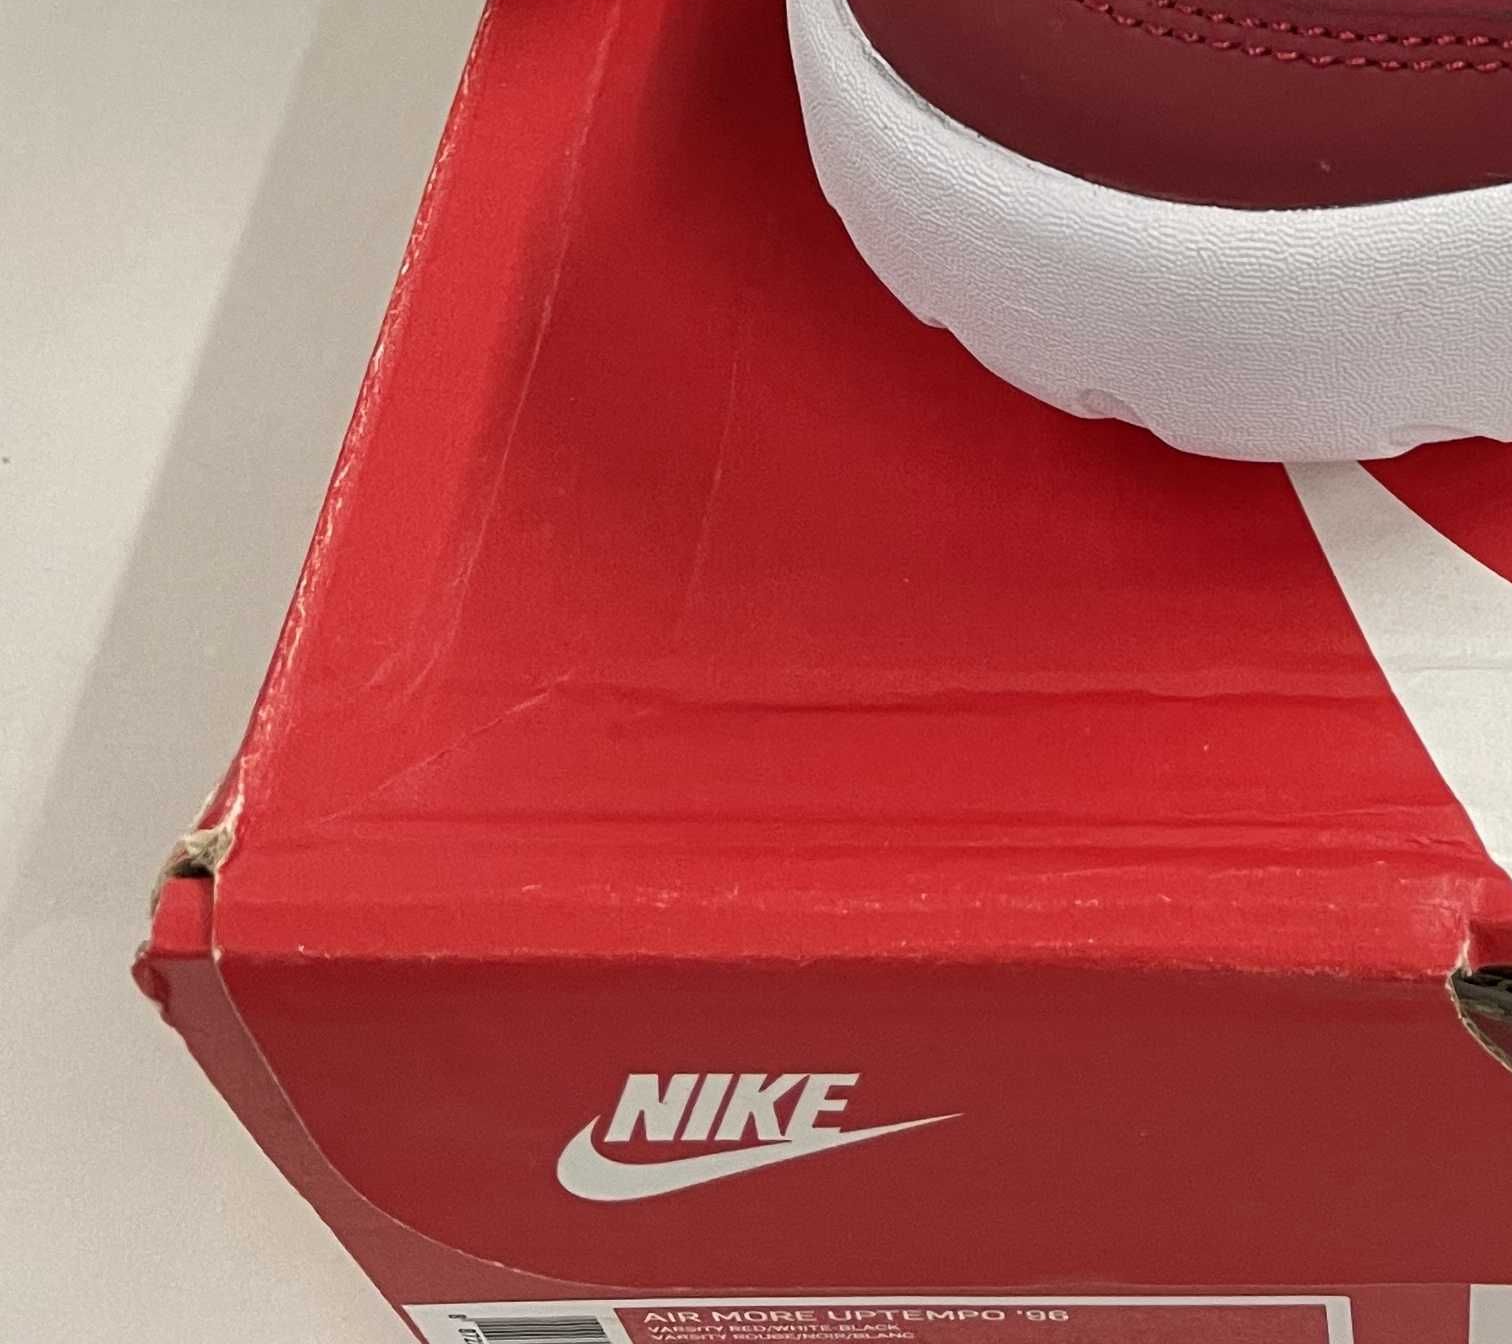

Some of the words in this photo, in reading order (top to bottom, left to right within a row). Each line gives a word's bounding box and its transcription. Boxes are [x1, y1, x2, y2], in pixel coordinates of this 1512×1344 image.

[603, 1073, 860, 1142] NIKE
[644, 1312, 701, 1323] AIR
[712, 1311, 817, 1322] MORE
[827, 1310, 1005, 1322] UPTEMPO
[1016, 1309, 1069, 1321] '96
